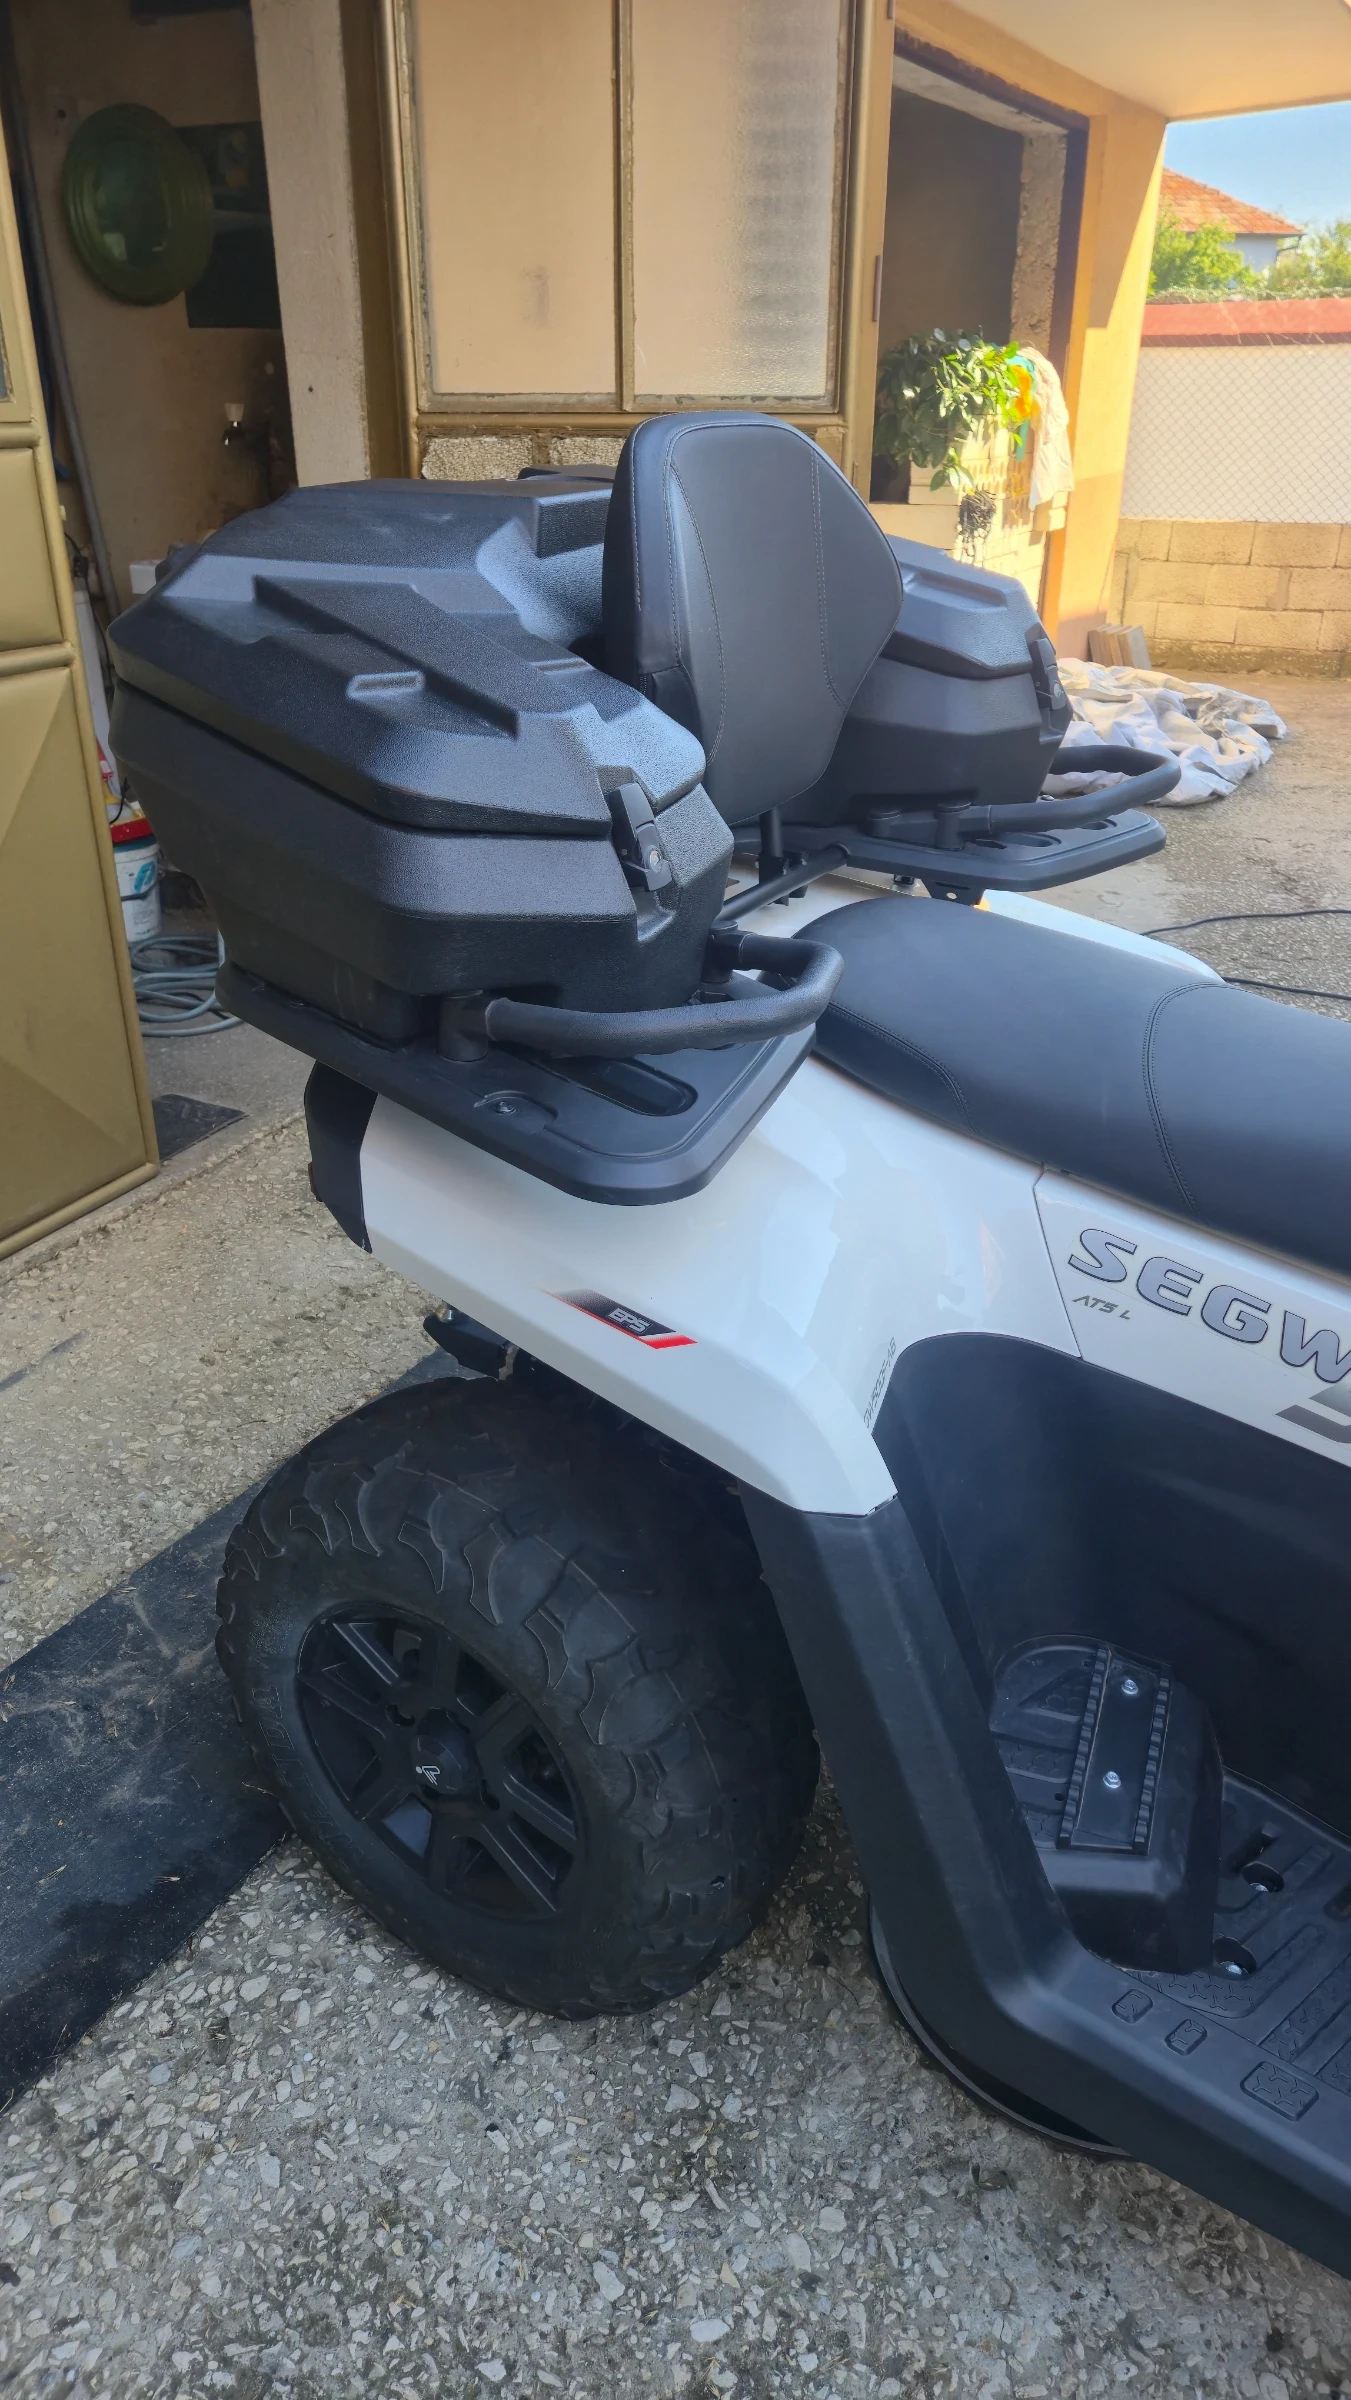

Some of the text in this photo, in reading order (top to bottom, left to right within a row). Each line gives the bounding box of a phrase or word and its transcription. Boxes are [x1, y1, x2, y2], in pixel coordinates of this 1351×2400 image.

[1067, 1228, 1351, 1384] SEGW
[1072, 1295, 1133, 1321] AT5 L
[606, 1307, 652, 1333] EPS
